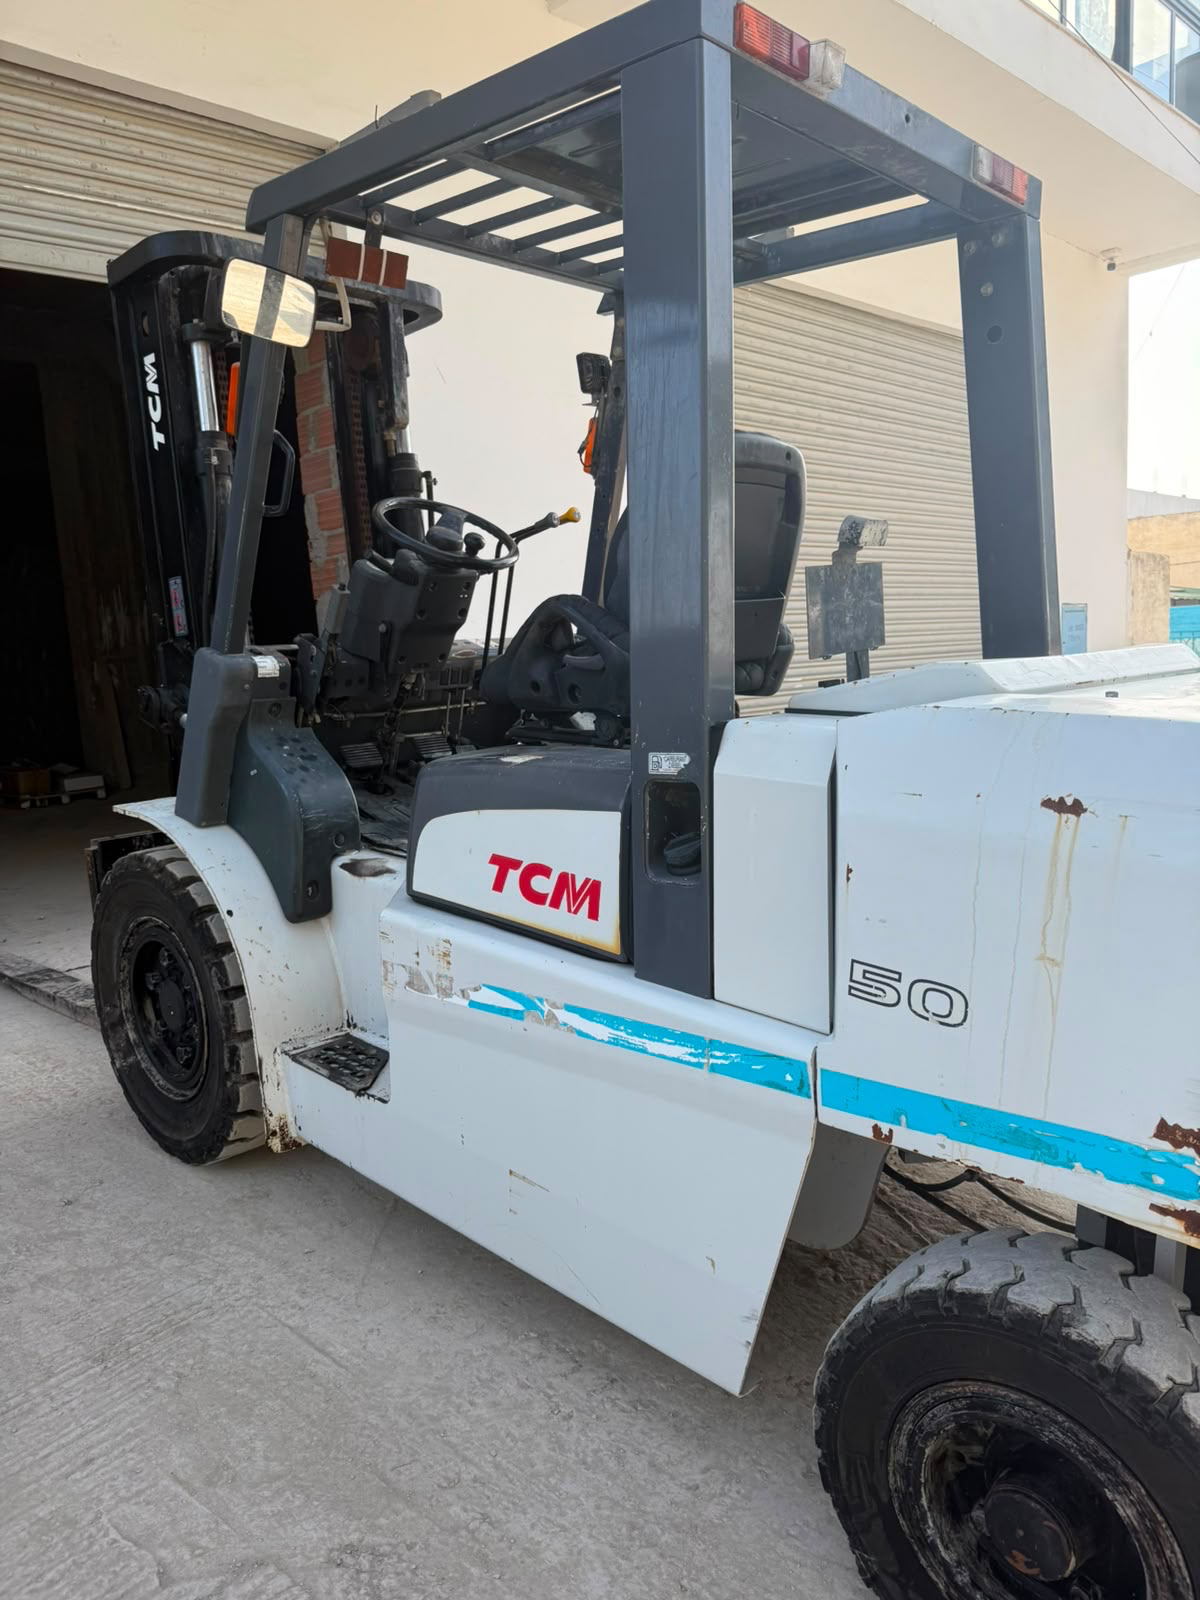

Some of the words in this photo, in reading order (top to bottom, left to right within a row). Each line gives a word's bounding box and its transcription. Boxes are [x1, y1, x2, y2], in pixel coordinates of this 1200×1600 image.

[143, 352, 166, 451] TCM
[488, 853, 602, 922] TCM
[848, 958, 968, 1028] 50
